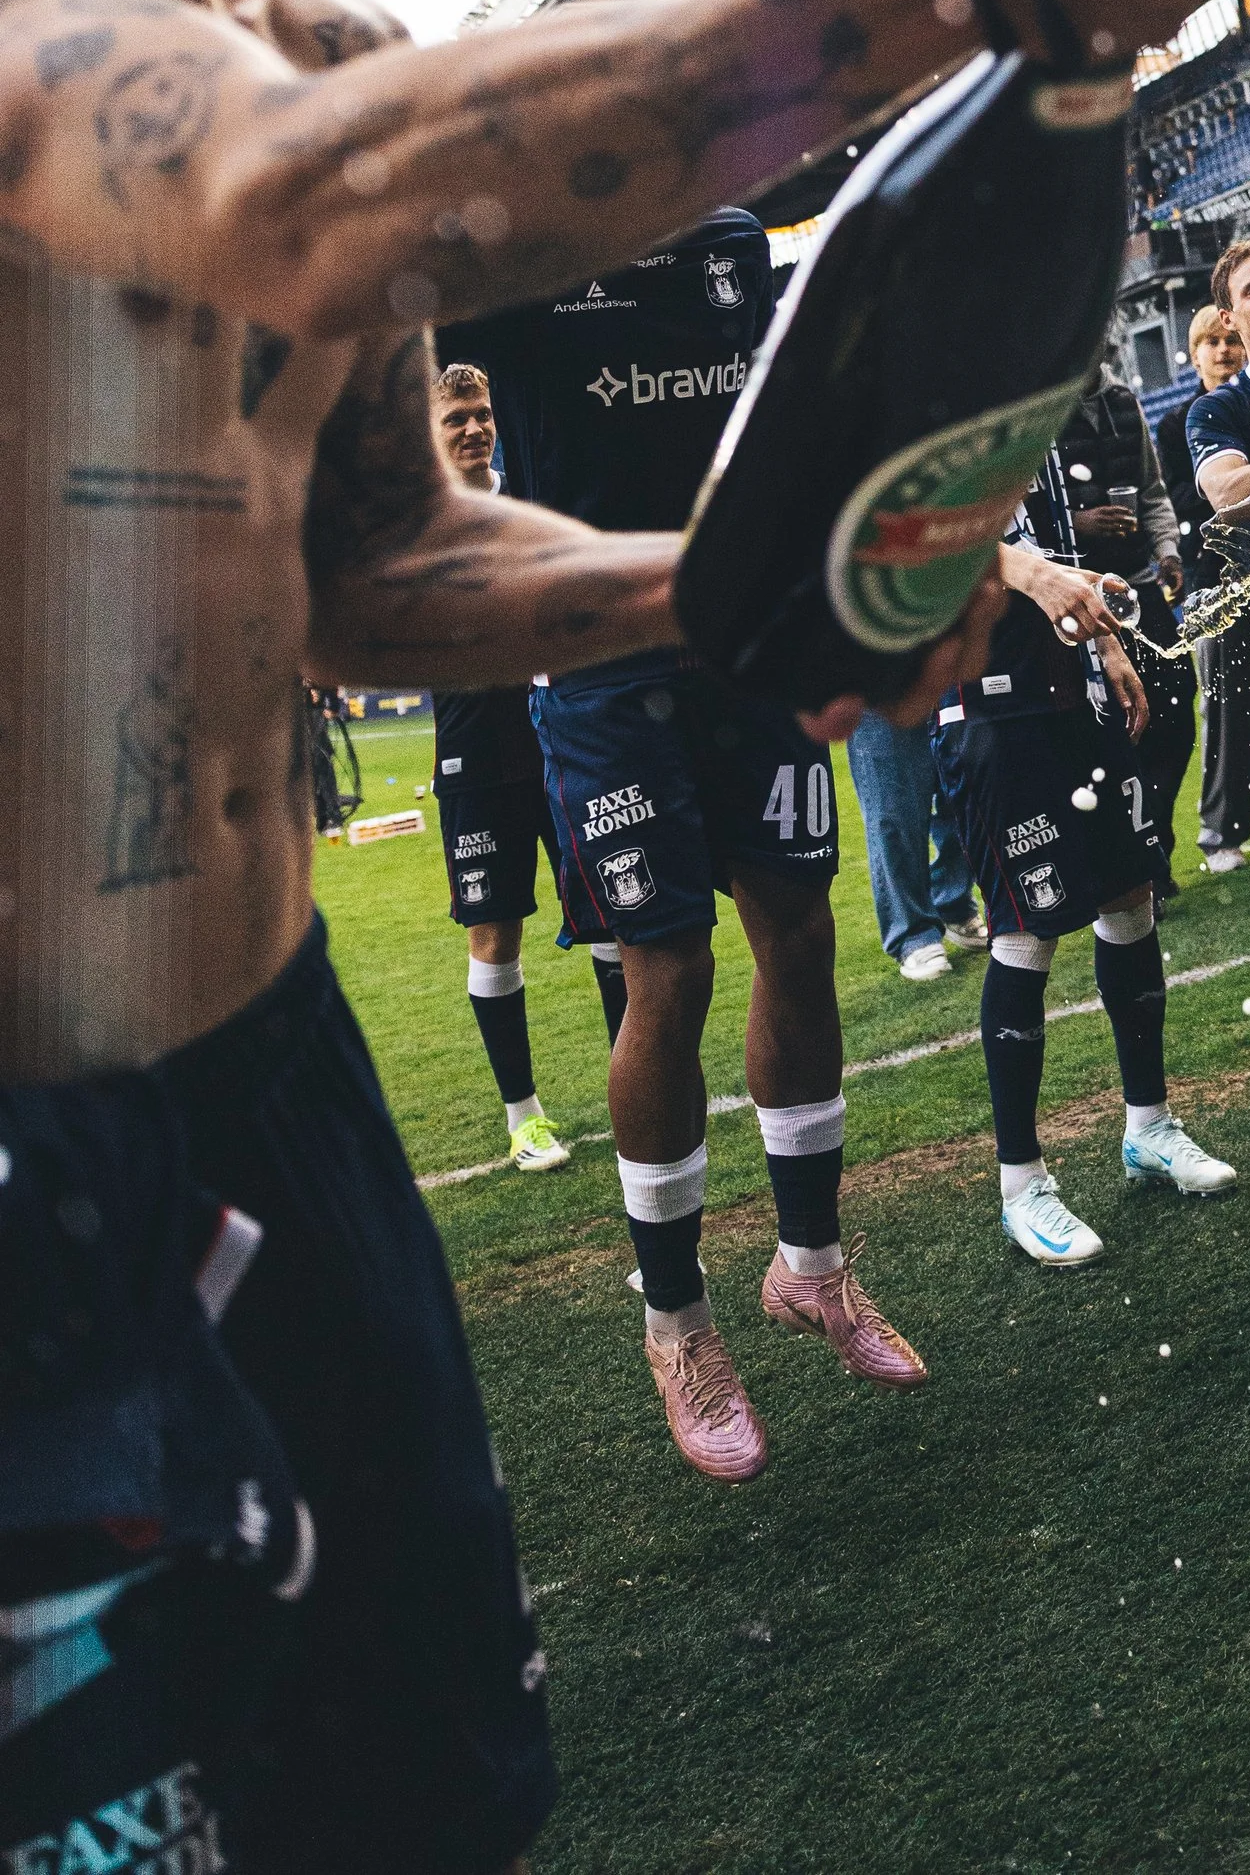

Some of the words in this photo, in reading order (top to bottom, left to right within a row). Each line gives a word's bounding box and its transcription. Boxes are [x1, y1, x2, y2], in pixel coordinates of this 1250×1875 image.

[631, 255, 666, 268] RAFT
[554, 298, 637, 313] Andelskassen
[630, 353, 747, 404] bravida
[586, 784, 643, 819] FAXE
[763, 763, 830, 840] 40
[1121, 776, 1154, 833] 2
[582, 799, 656, 841] KONDI
[1006, 813, 1050, 842] FAXE
[454, 841, 497, 859] KONDI
[458, 831, 491, 847] FAXE
[1004, 825, 1060, 859] KONDI
